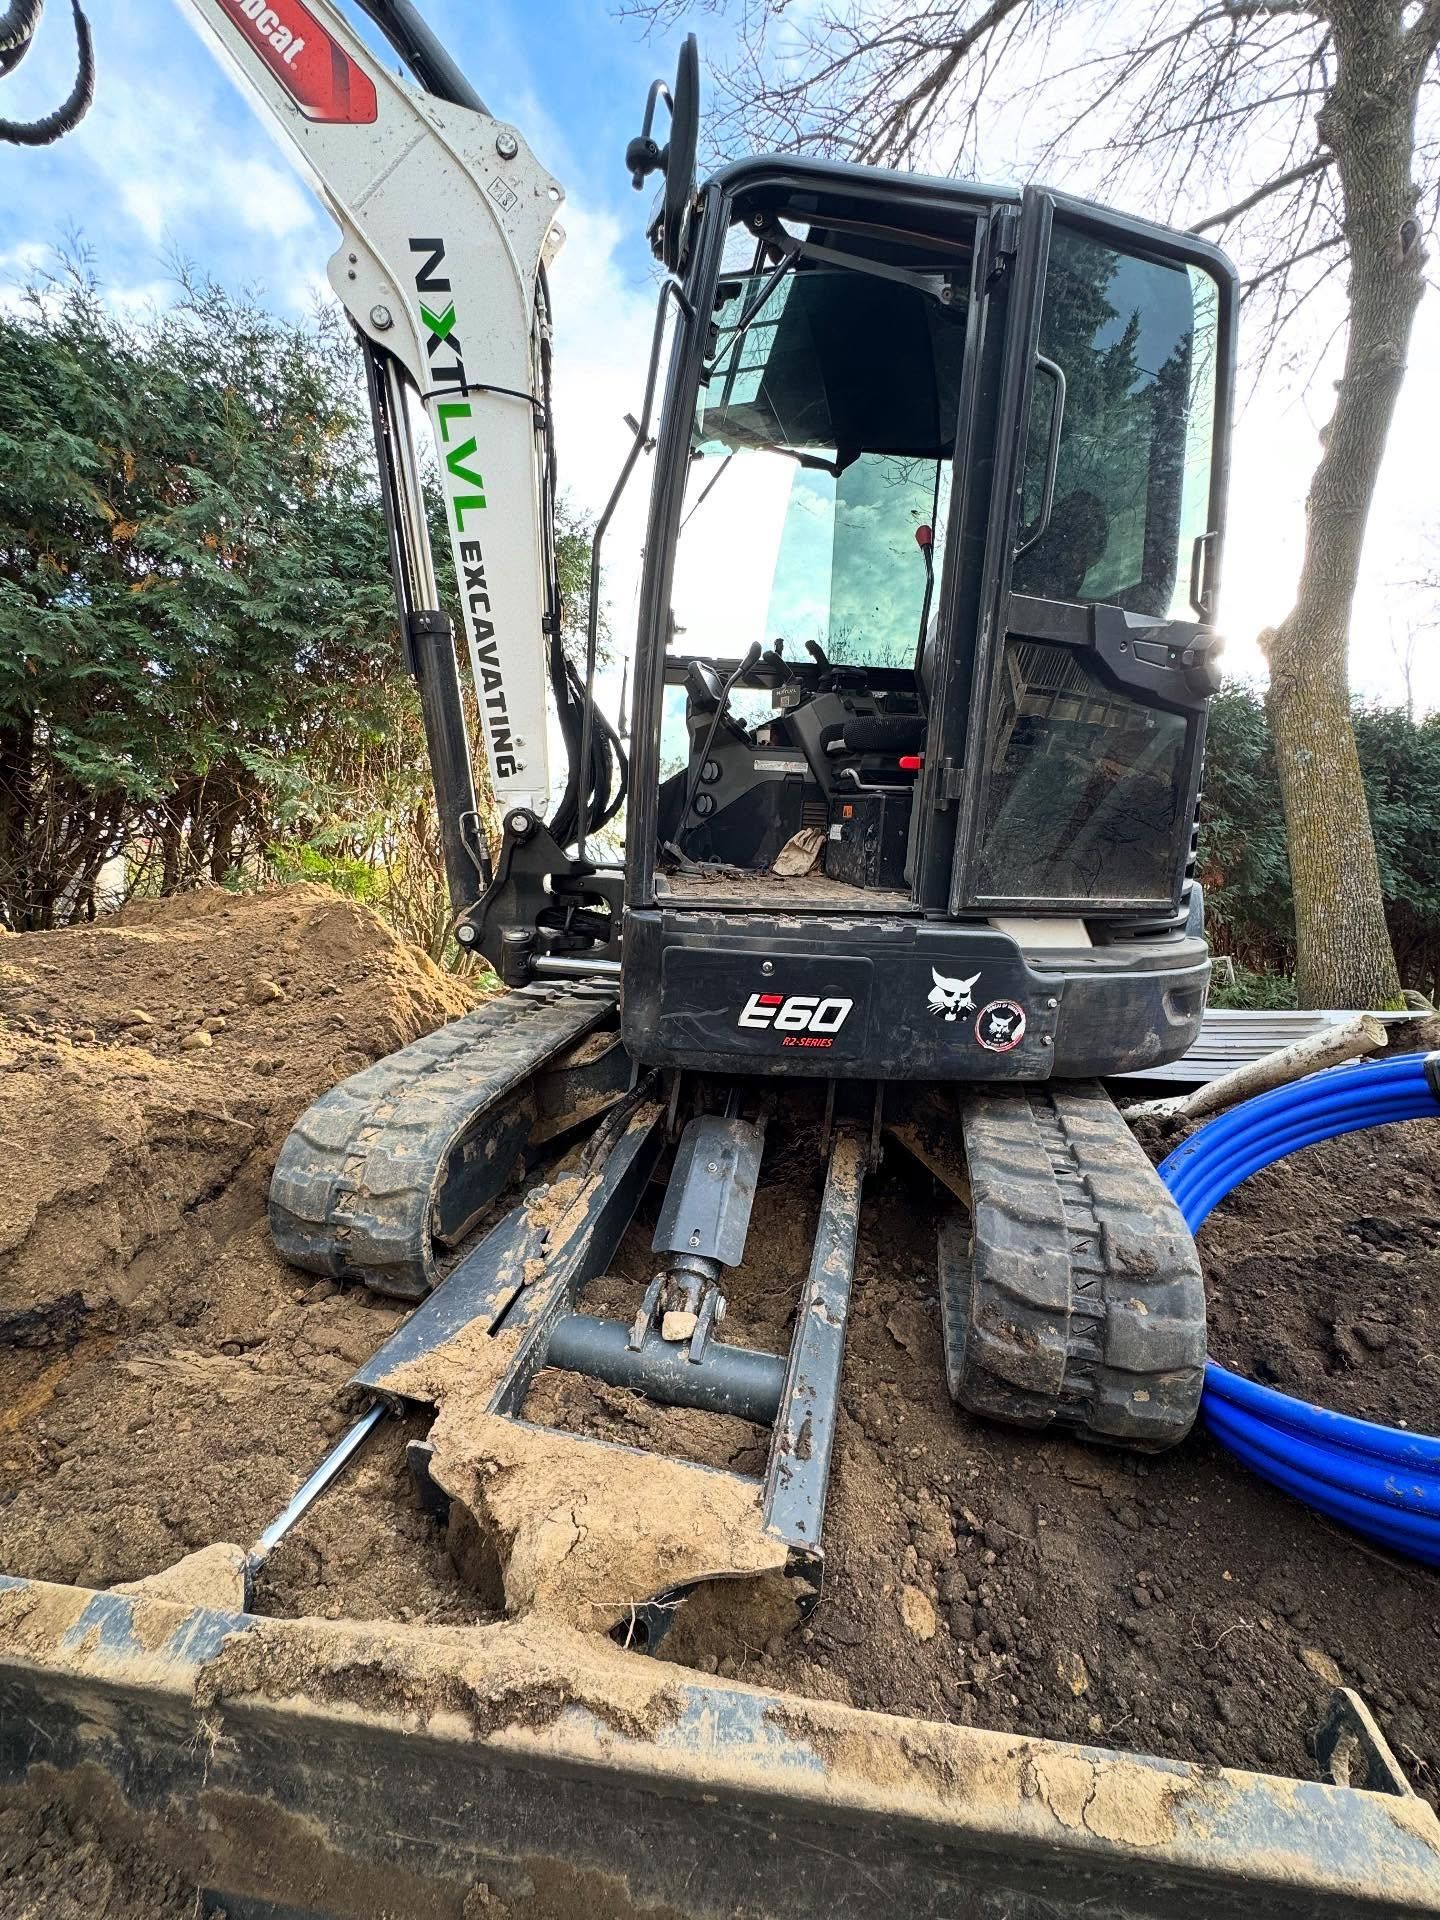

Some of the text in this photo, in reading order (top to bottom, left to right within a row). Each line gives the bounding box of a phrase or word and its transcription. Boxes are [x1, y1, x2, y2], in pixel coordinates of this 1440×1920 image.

[233, 0, 305, 64] bcat
[459, 540, 517, 779] EXCAVATING
[738, 993, 854, 1033] E60
[782, 1037, 834, 1048] R2-SERIES
